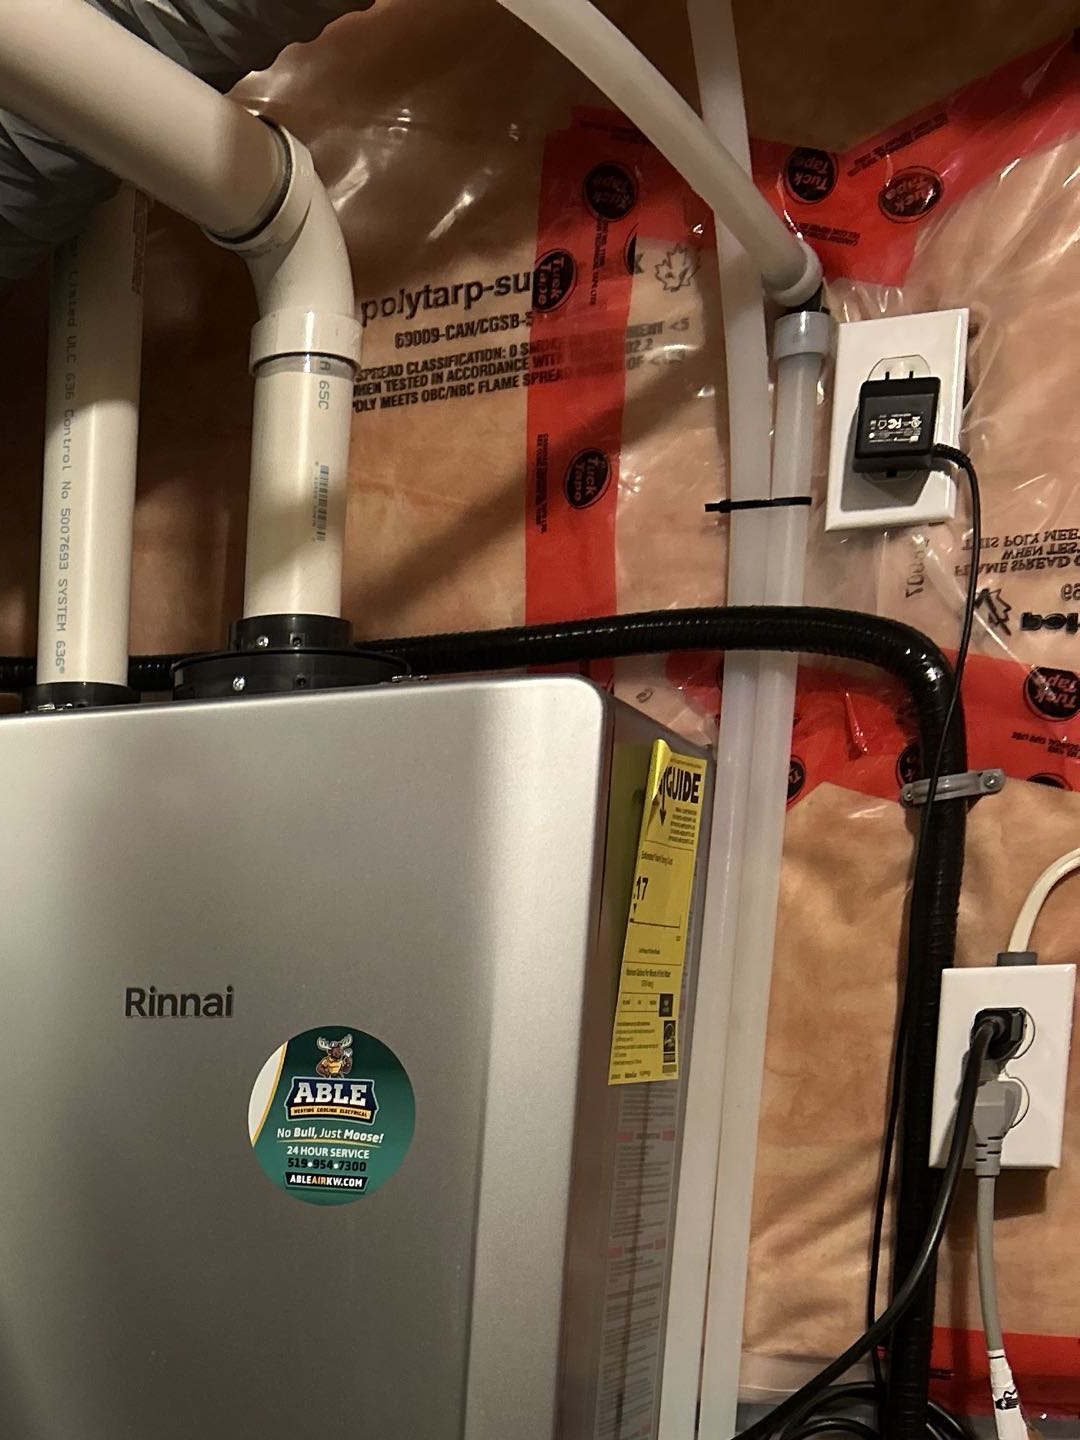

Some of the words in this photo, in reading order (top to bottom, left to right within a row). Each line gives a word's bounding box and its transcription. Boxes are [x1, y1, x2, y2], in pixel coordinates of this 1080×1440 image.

[793, 172, 828, 191] Tuck
[551, 257, 565, 300] Tuck
[361, 271, 534, 328] polytarp-su
[395, 311, 533, 349] 69009-CAN/CGSB-5
[63, 373, 76, 399] 636
[355, 364, 403, 382] SPREAD
[386, 374, 428, 393] TESTED
[431, 371, 444, 385] IN
[446, 358, 529, 382] ACCORDANCE
[380, 392, 418, 410] MEETS
[422, 382, 475, 403] OBC/NBC
[478, 376, 519, 394] FLAME
[60, 408, 76, 472] Control
[61, 481, 73, 500] No
[58, 508, 71, 570] 5007693
[56, 579, 69, 632] SYSTEM
[666, 766, 702, 804] GUIDE
[125, 985, 235, 1018] Rinnai
[293, 1082, 367, 1106] ABLE
[277, 1127, 291, 1138] No
[293, 1127, 317, 1139] Bull,
[319, 1127, 341, 1139] Just
[343, 1129, 384, 1144] Moose!
[286, 1146, 298, 1155] 24
[300, 1146, 328, 1157] HOUR
[330, 1148, 370, 1159] SERVICE
[290, 1175, 363, 1187] ABLEAIRKW.COM
